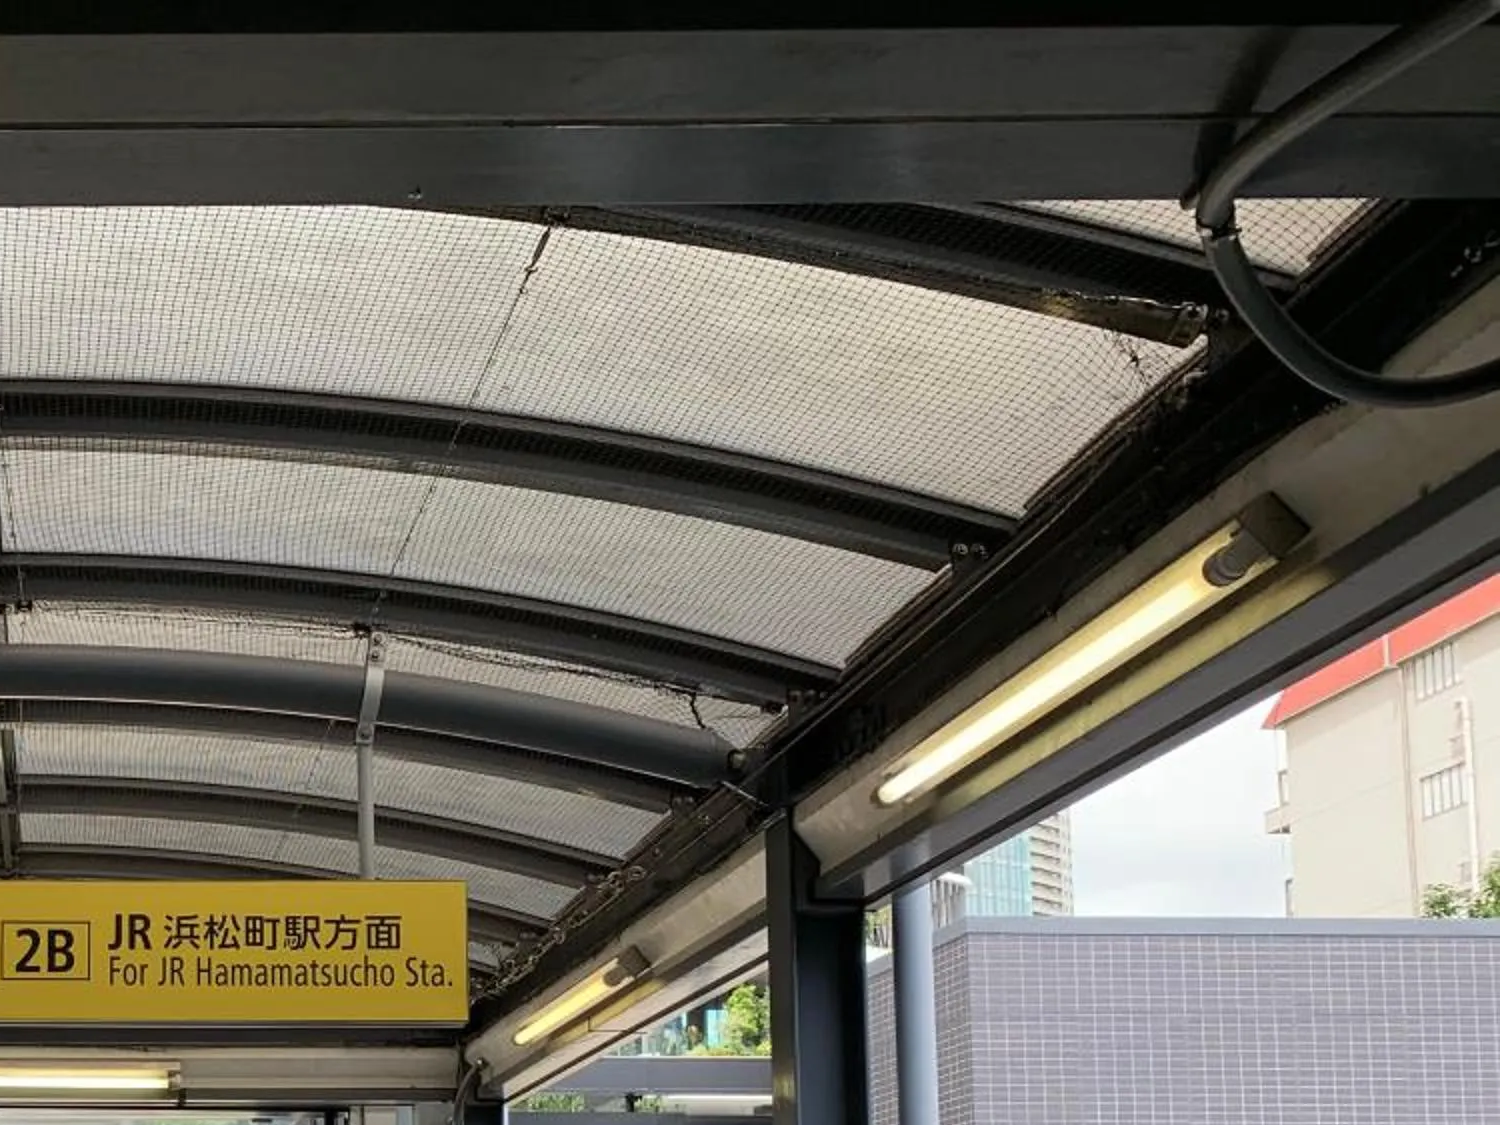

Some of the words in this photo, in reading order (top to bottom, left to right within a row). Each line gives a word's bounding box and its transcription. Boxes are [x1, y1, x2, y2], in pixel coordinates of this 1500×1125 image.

[15, 928, 75, 973] 2B
[107, 913, 152, 951] JR
[163, 914, 403, 951] 浜松町駅方面
[108, 956, 149, 987] For
[157, 957, 186, 987] JR
[197, 955, 396, 988] Hamamatsucho
[405, 957, 455, 988] Sta.
